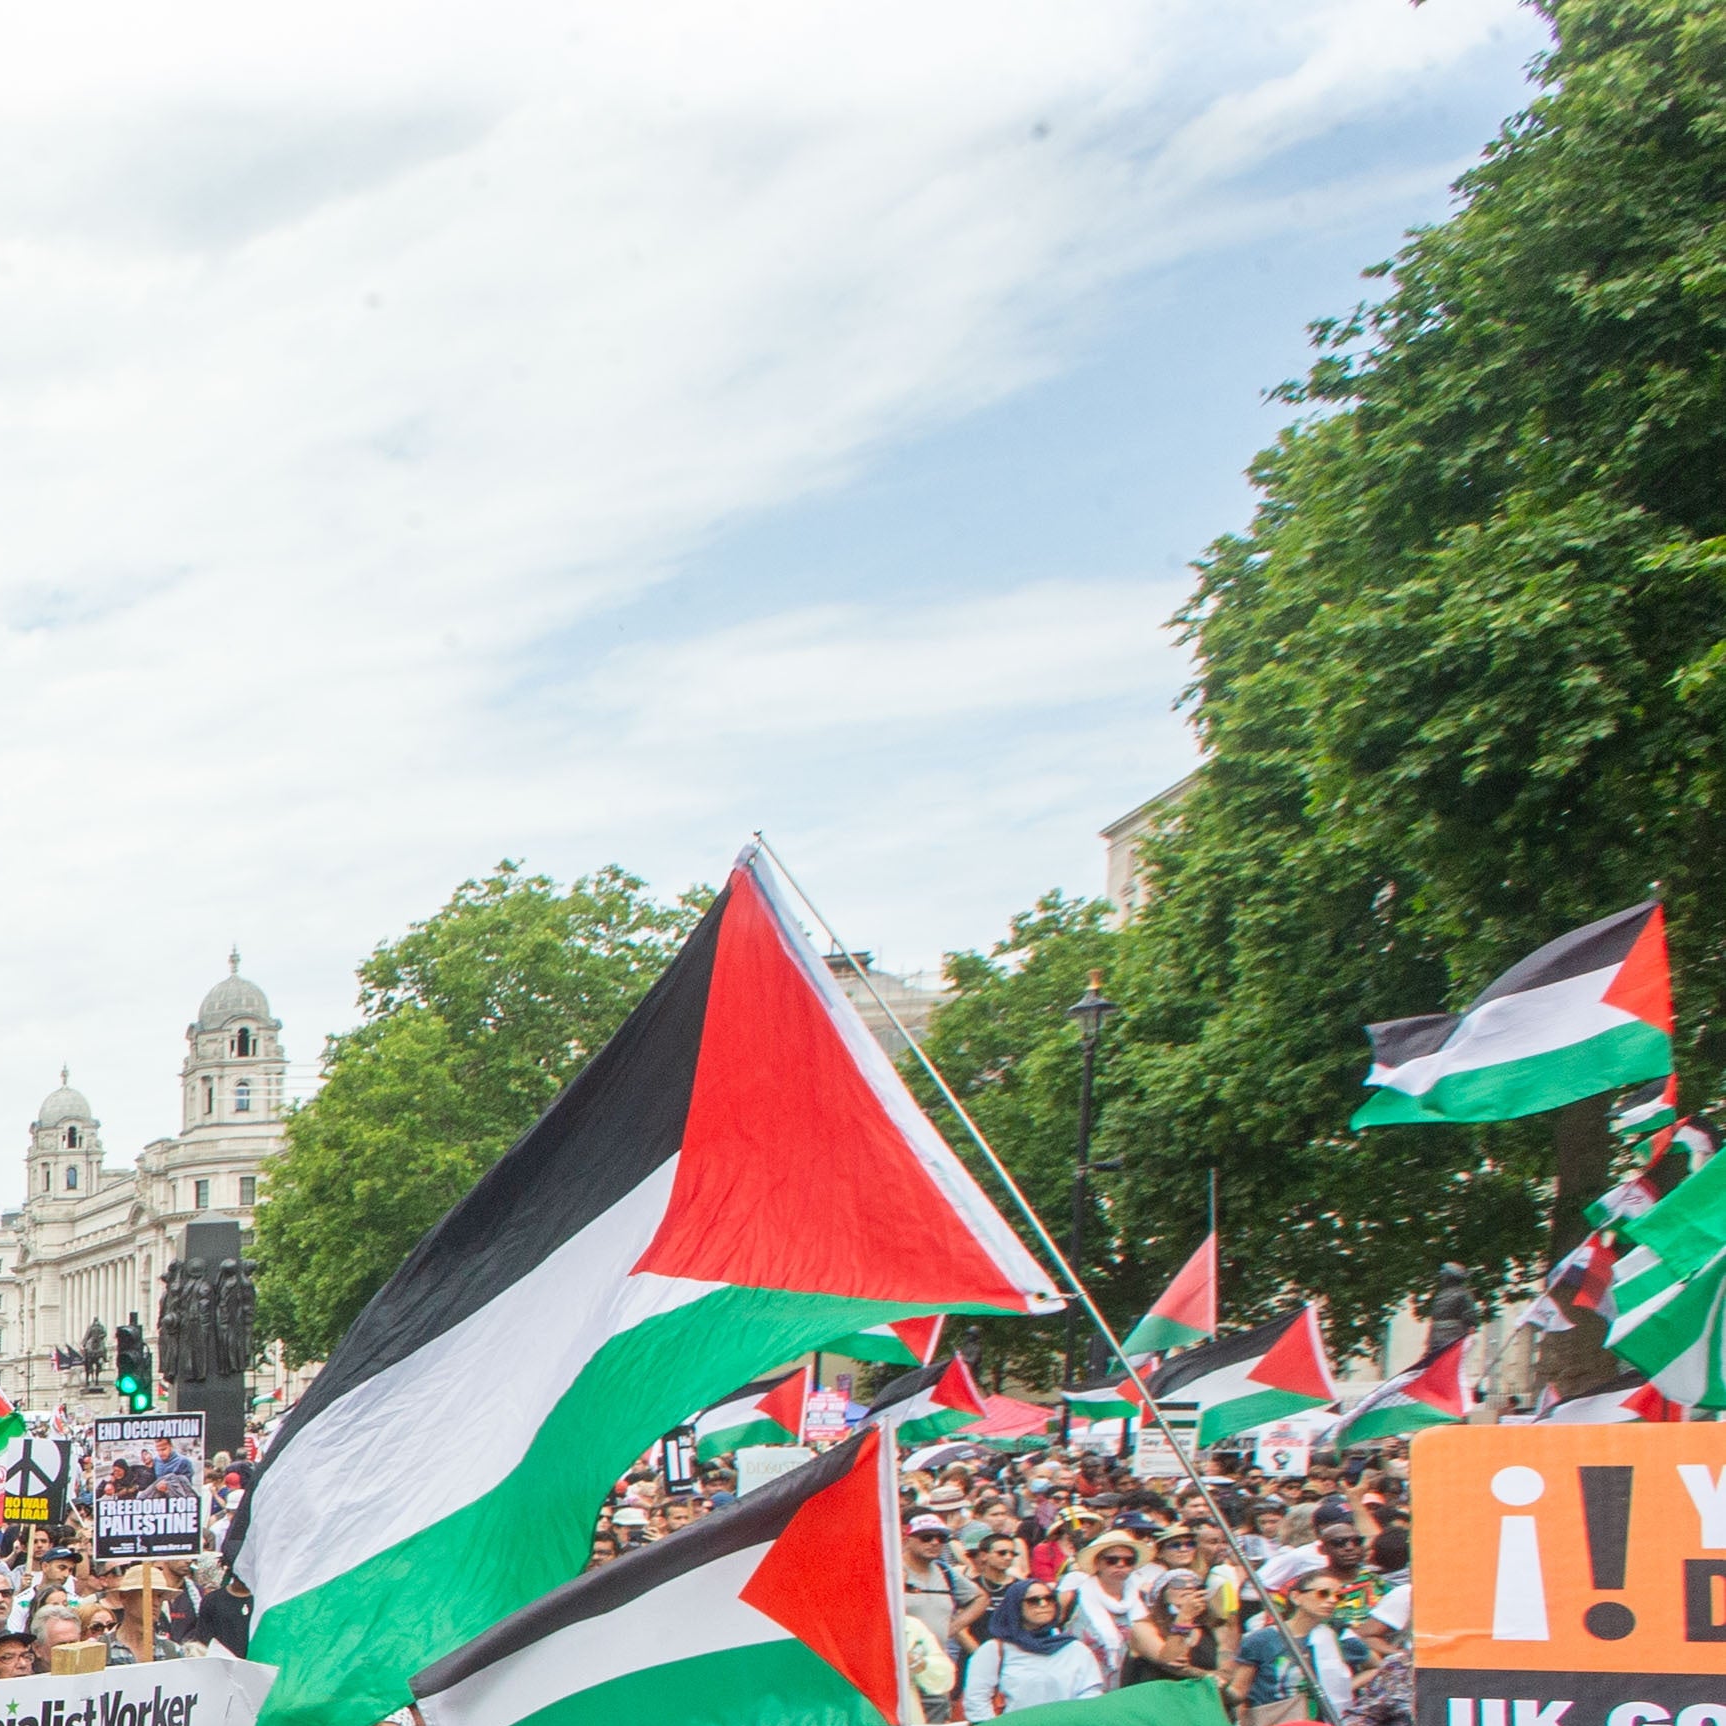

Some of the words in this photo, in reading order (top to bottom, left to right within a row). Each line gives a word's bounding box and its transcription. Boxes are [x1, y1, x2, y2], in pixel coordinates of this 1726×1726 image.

[97, 1422, 121, 1440] END
[123, 1419, 199, 1439] OCCUPATION
[5, 1497, 20, 1508] NO
[22, 1497, 48, 1509] WAR
[100, 1498, 166, 1515] FREEDOM
[169, 1497, 197, 1513] FOR
[4, 1508, 20, 1519] ON
[21, 1509, 48, 1520] IRAN
[99, 1513, 198, 1537] PALESTINE
